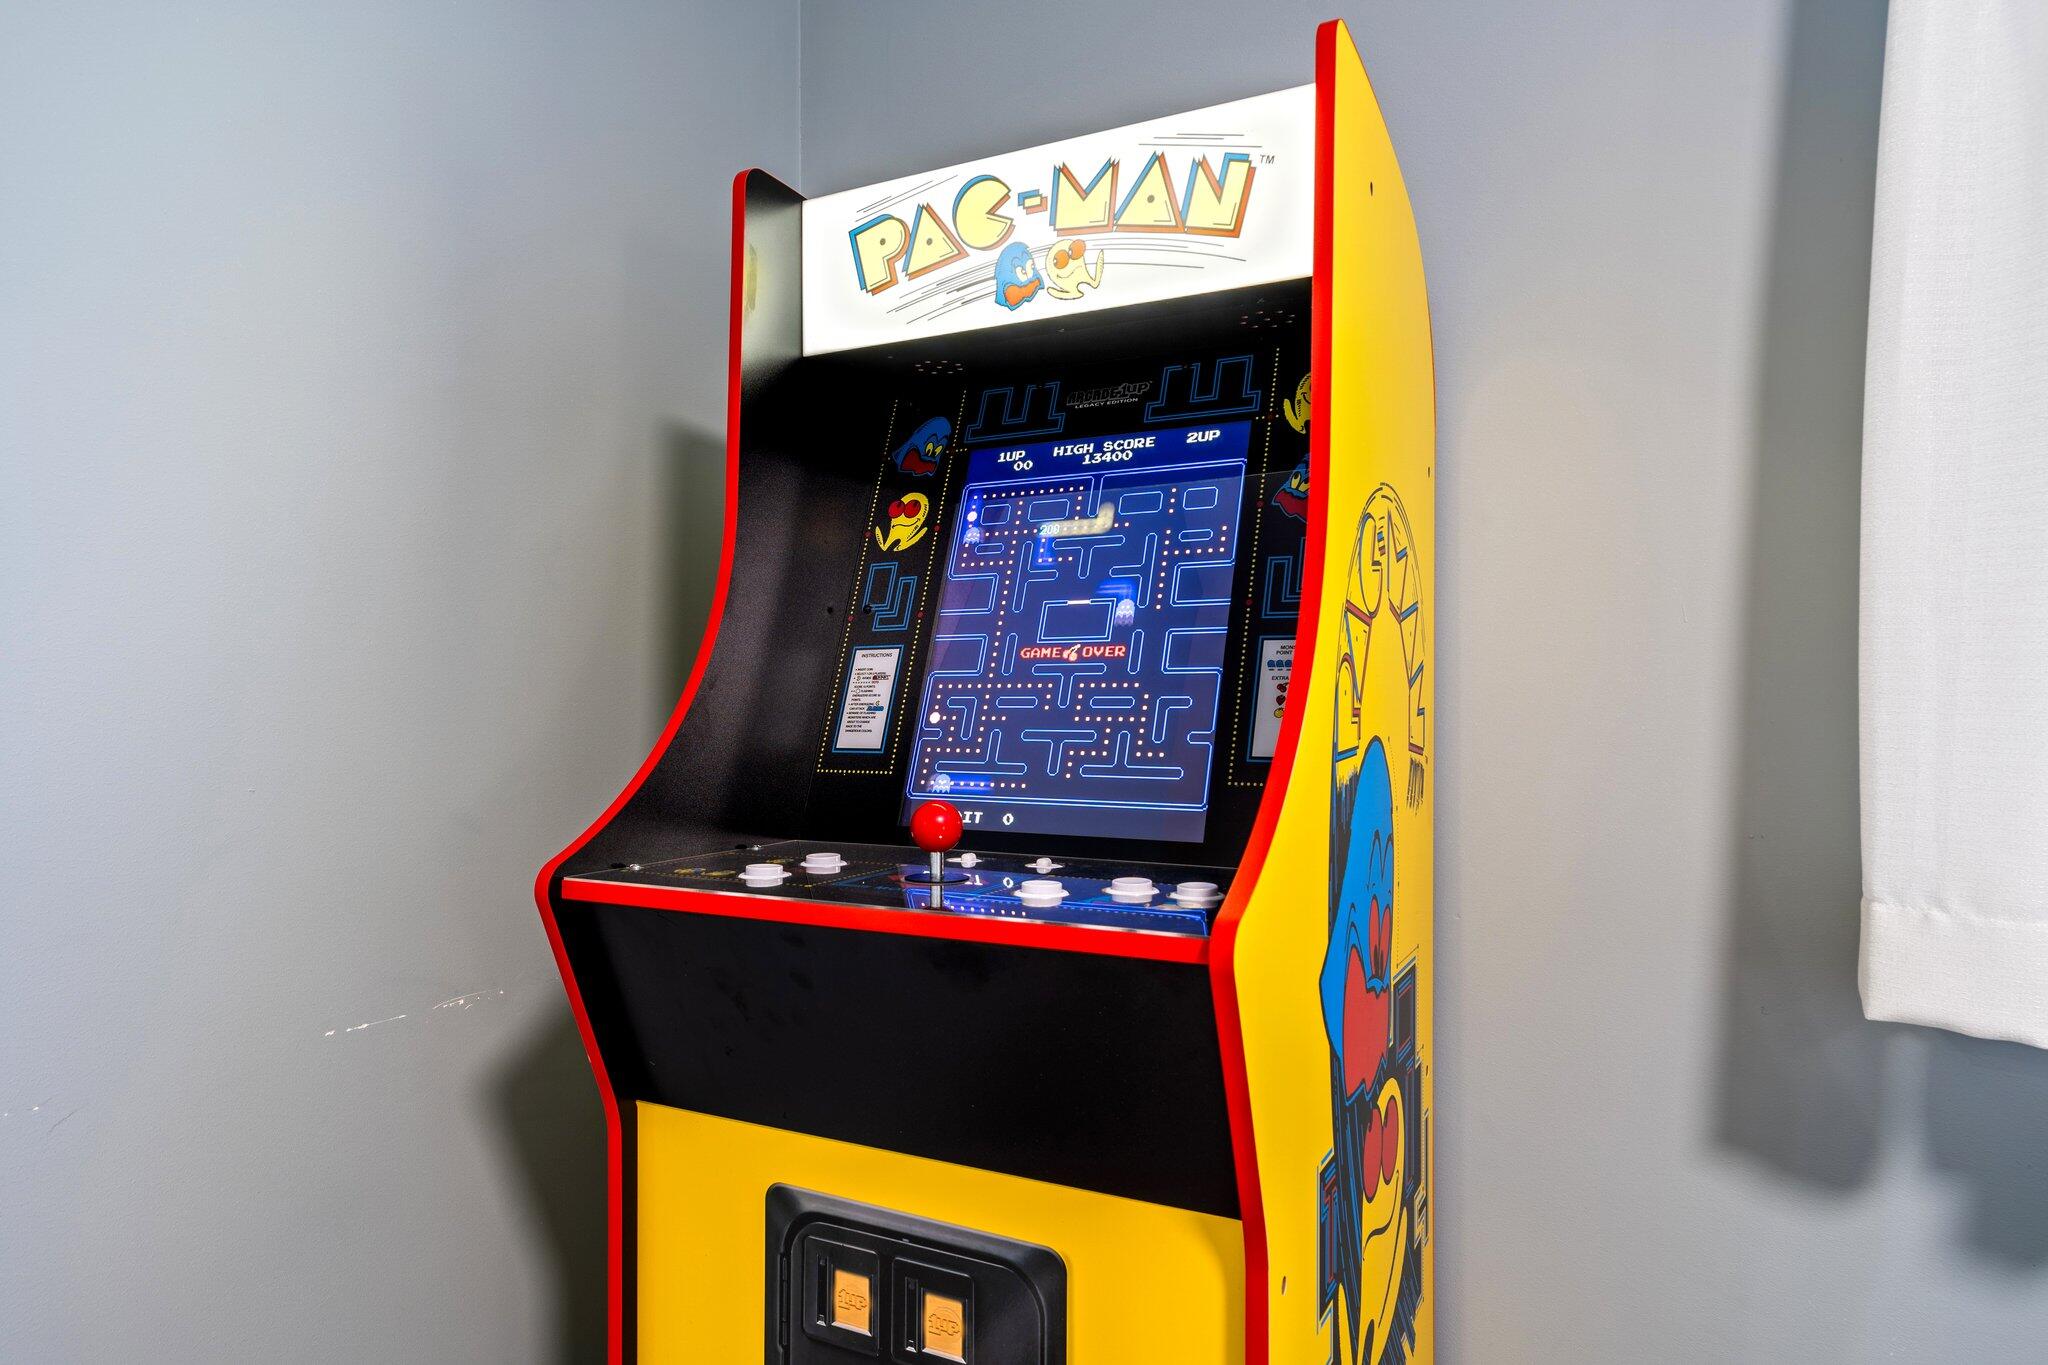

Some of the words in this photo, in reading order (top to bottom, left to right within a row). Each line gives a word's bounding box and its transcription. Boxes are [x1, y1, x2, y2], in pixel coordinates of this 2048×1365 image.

[849, 151, 1257, 297] PAC-MAN
[1106, 397, 1139, 405] EDITION
[998, 449, 1026, 463] 1UP
[1053, 443, 1094, 457] HIGH
[1102, 436, 1156, 452] SCORE
[1186, 429, 1221, 444] 2UP
[1013, 459, 1034, 471] 00
[1082, 450, 1133, 465] 13400
[1020, 646, 1061, 659] GAME
[1082, 645, 1126, 658] OVER
